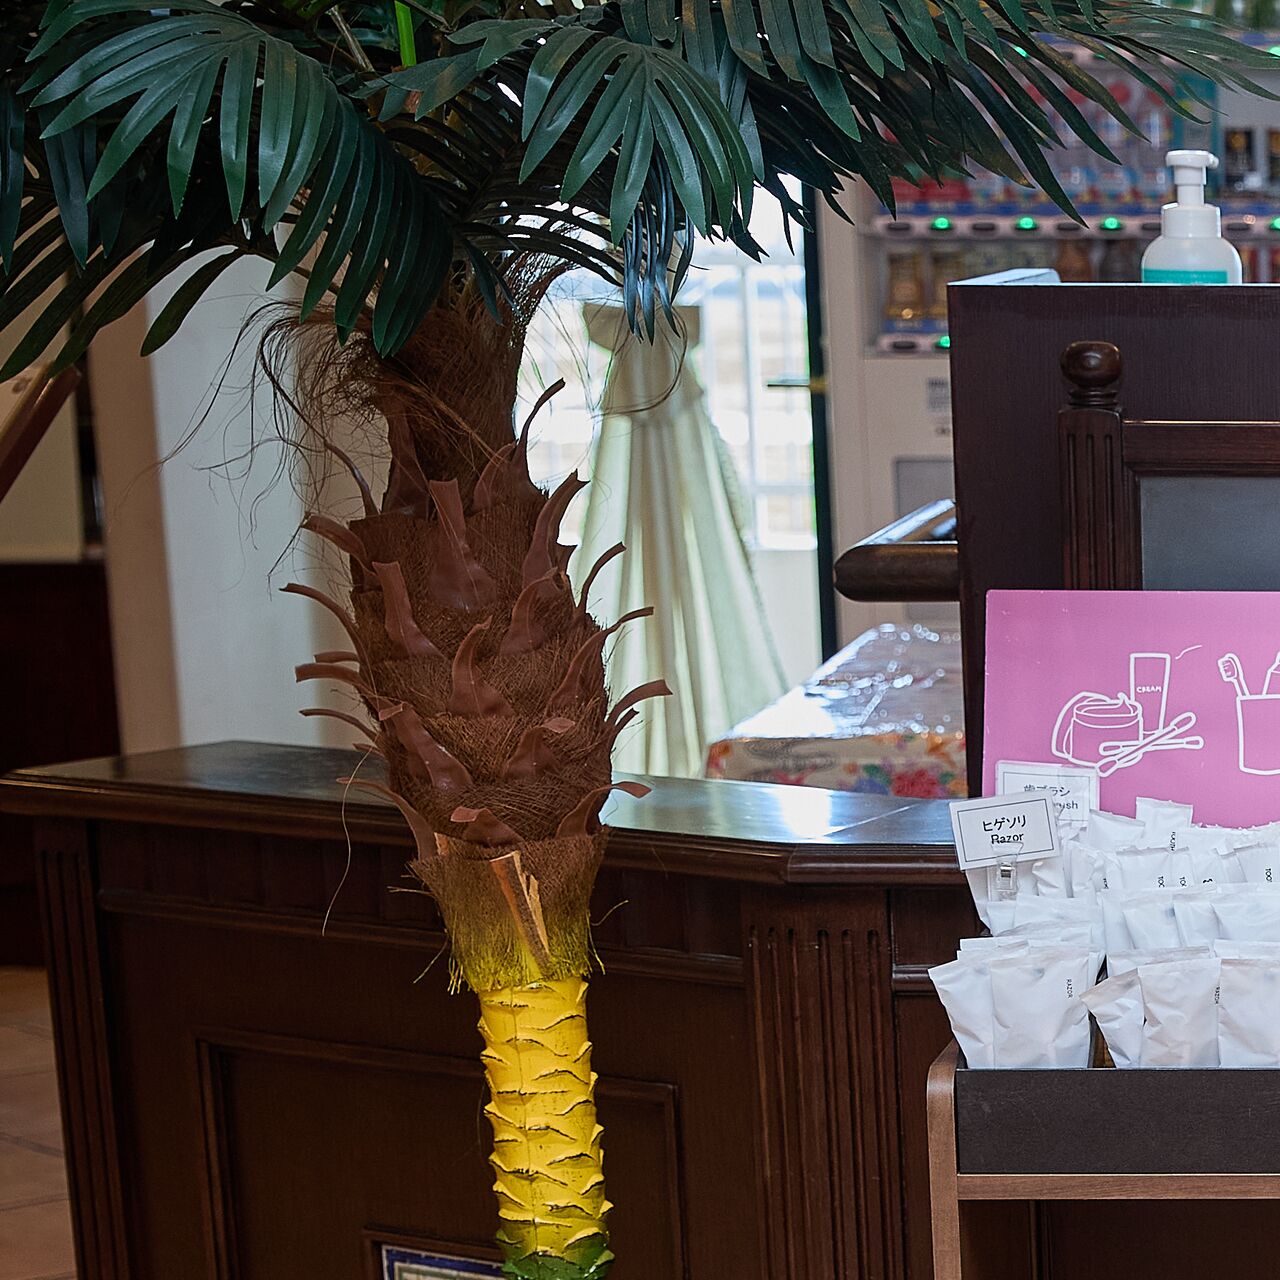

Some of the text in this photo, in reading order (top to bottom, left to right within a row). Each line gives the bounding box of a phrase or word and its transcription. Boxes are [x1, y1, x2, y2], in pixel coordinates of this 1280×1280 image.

[1135, 685, 1163, 694] CREAM
[982, 814, 1027, 832] ヒゲソリ
[990, 833, 1024, 845] Razor
[1066, 978, 1074, 998] RAZOR
